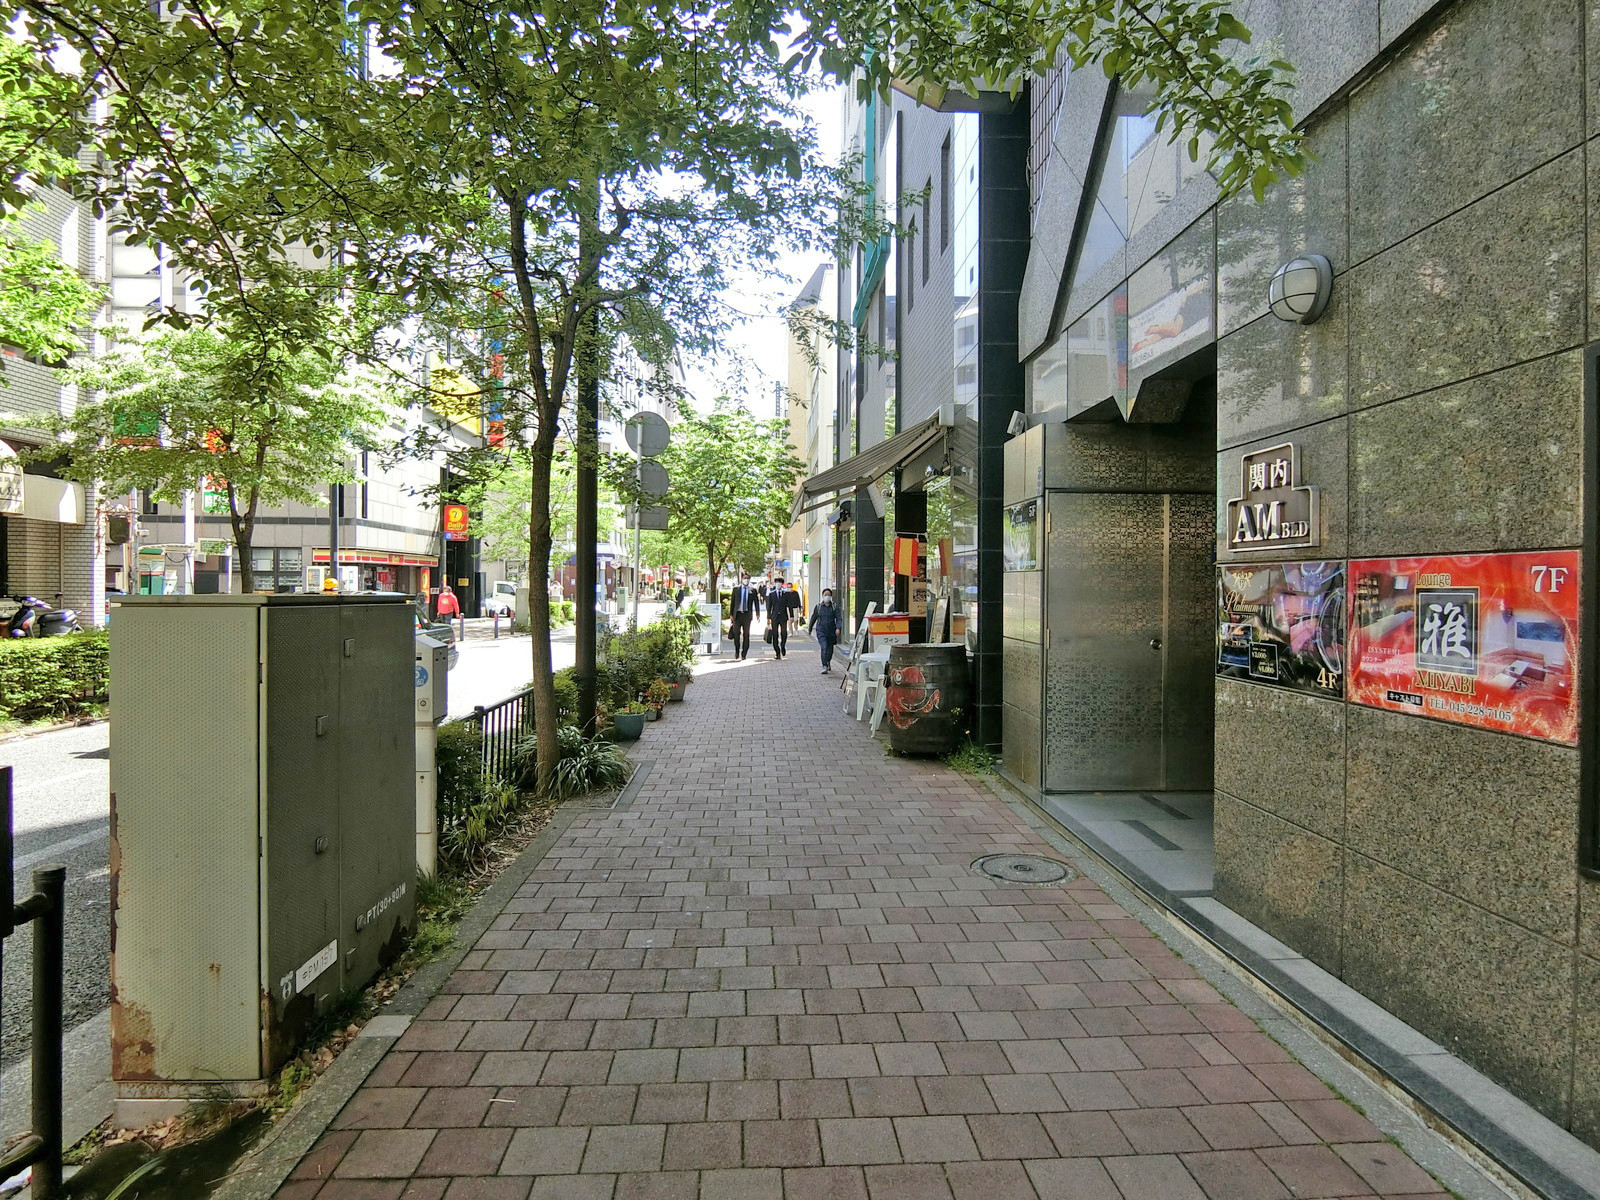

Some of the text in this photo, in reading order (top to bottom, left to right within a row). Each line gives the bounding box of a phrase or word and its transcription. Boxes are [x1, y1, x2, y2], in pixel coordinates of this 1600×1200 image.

[1249, 458, 1288, 491] 関内
[447, 521, 465, 530] Daily
[1232, 501, 1309, 543] AM BLD
[1415, 571, 1451, 587] Lounge
[1530, 565, 1569, 593] 7F
[1224, 589, 1259, 613] Platinum
[1421, 602, 1471, 658] 雅
[1316, 667, 1338, 689] 4F
[1416, 670, 1476, 695] MIYABI
[1430, 698, 1447, 709] TEL
